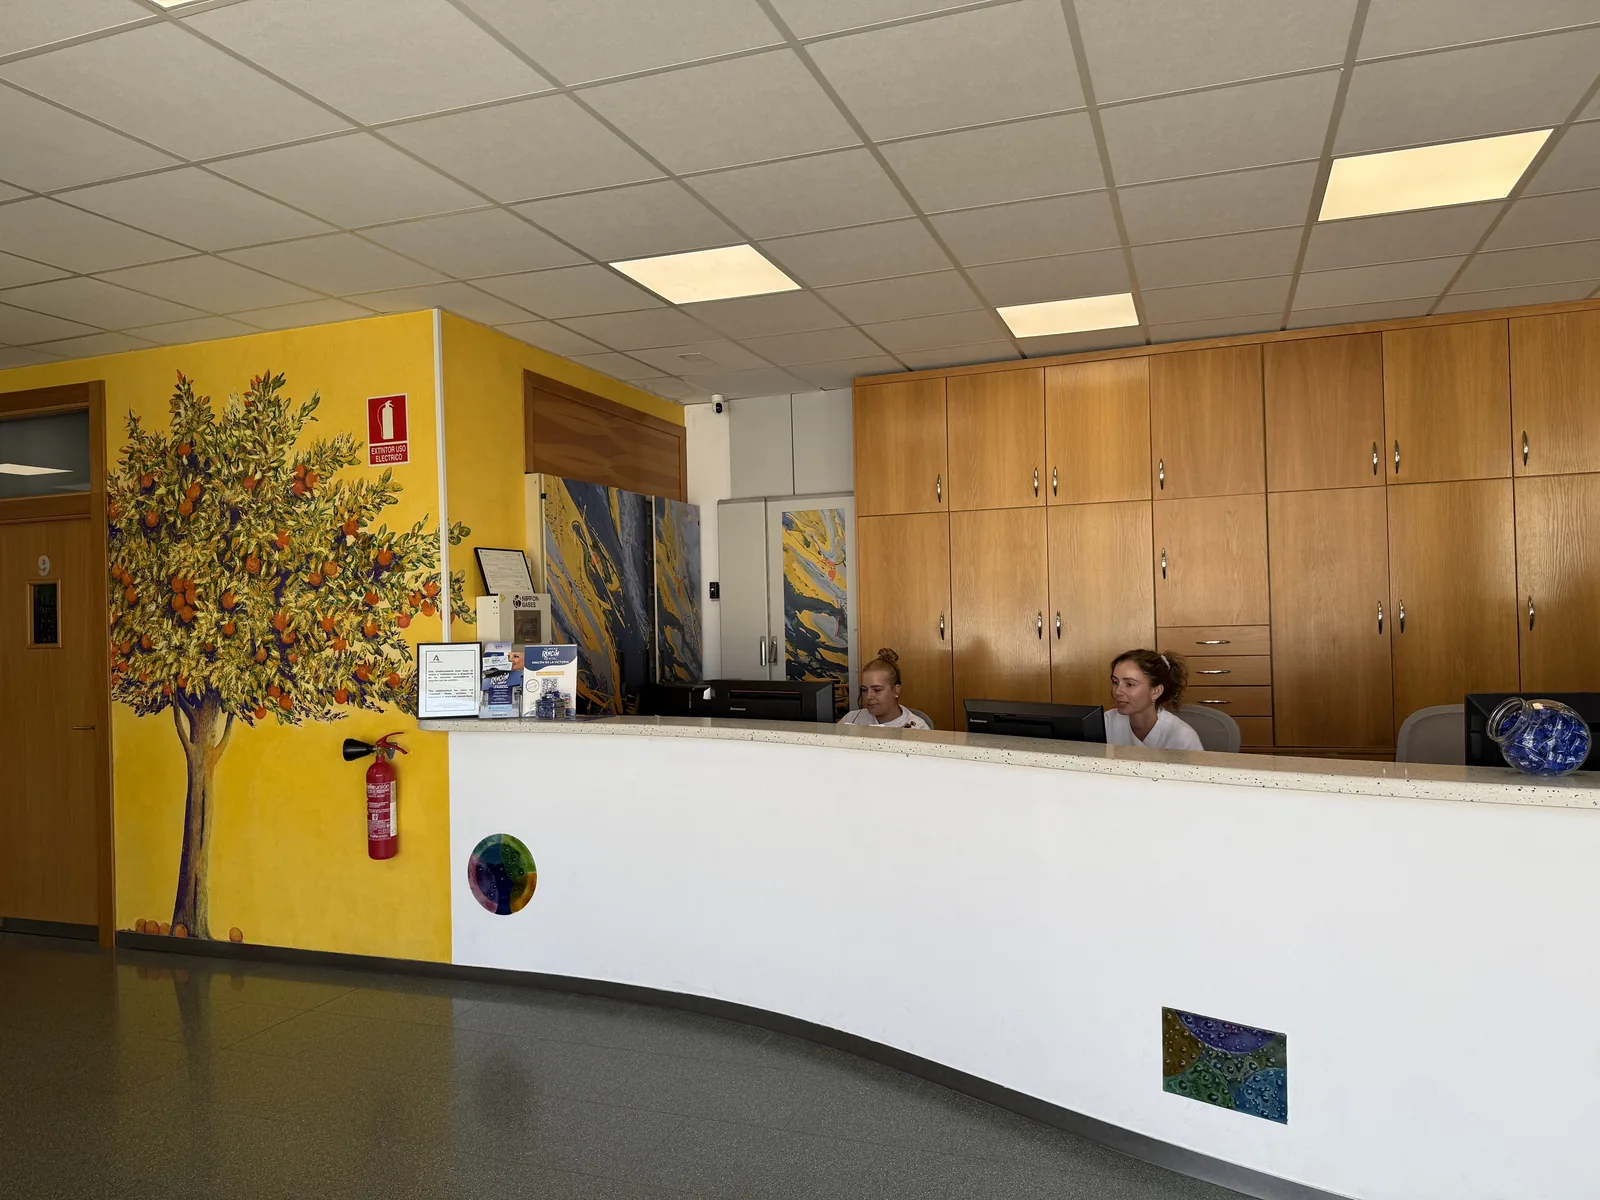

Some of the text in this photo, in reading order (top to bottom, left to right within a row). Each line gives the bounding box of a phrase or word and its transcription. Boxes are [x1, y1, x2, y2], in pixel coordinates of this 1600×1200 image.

[371, 446, 395, 454] EXTINTOR
[376, 454, 402, 462] ELECTRICO
[38, 555, 50, 576] 9
